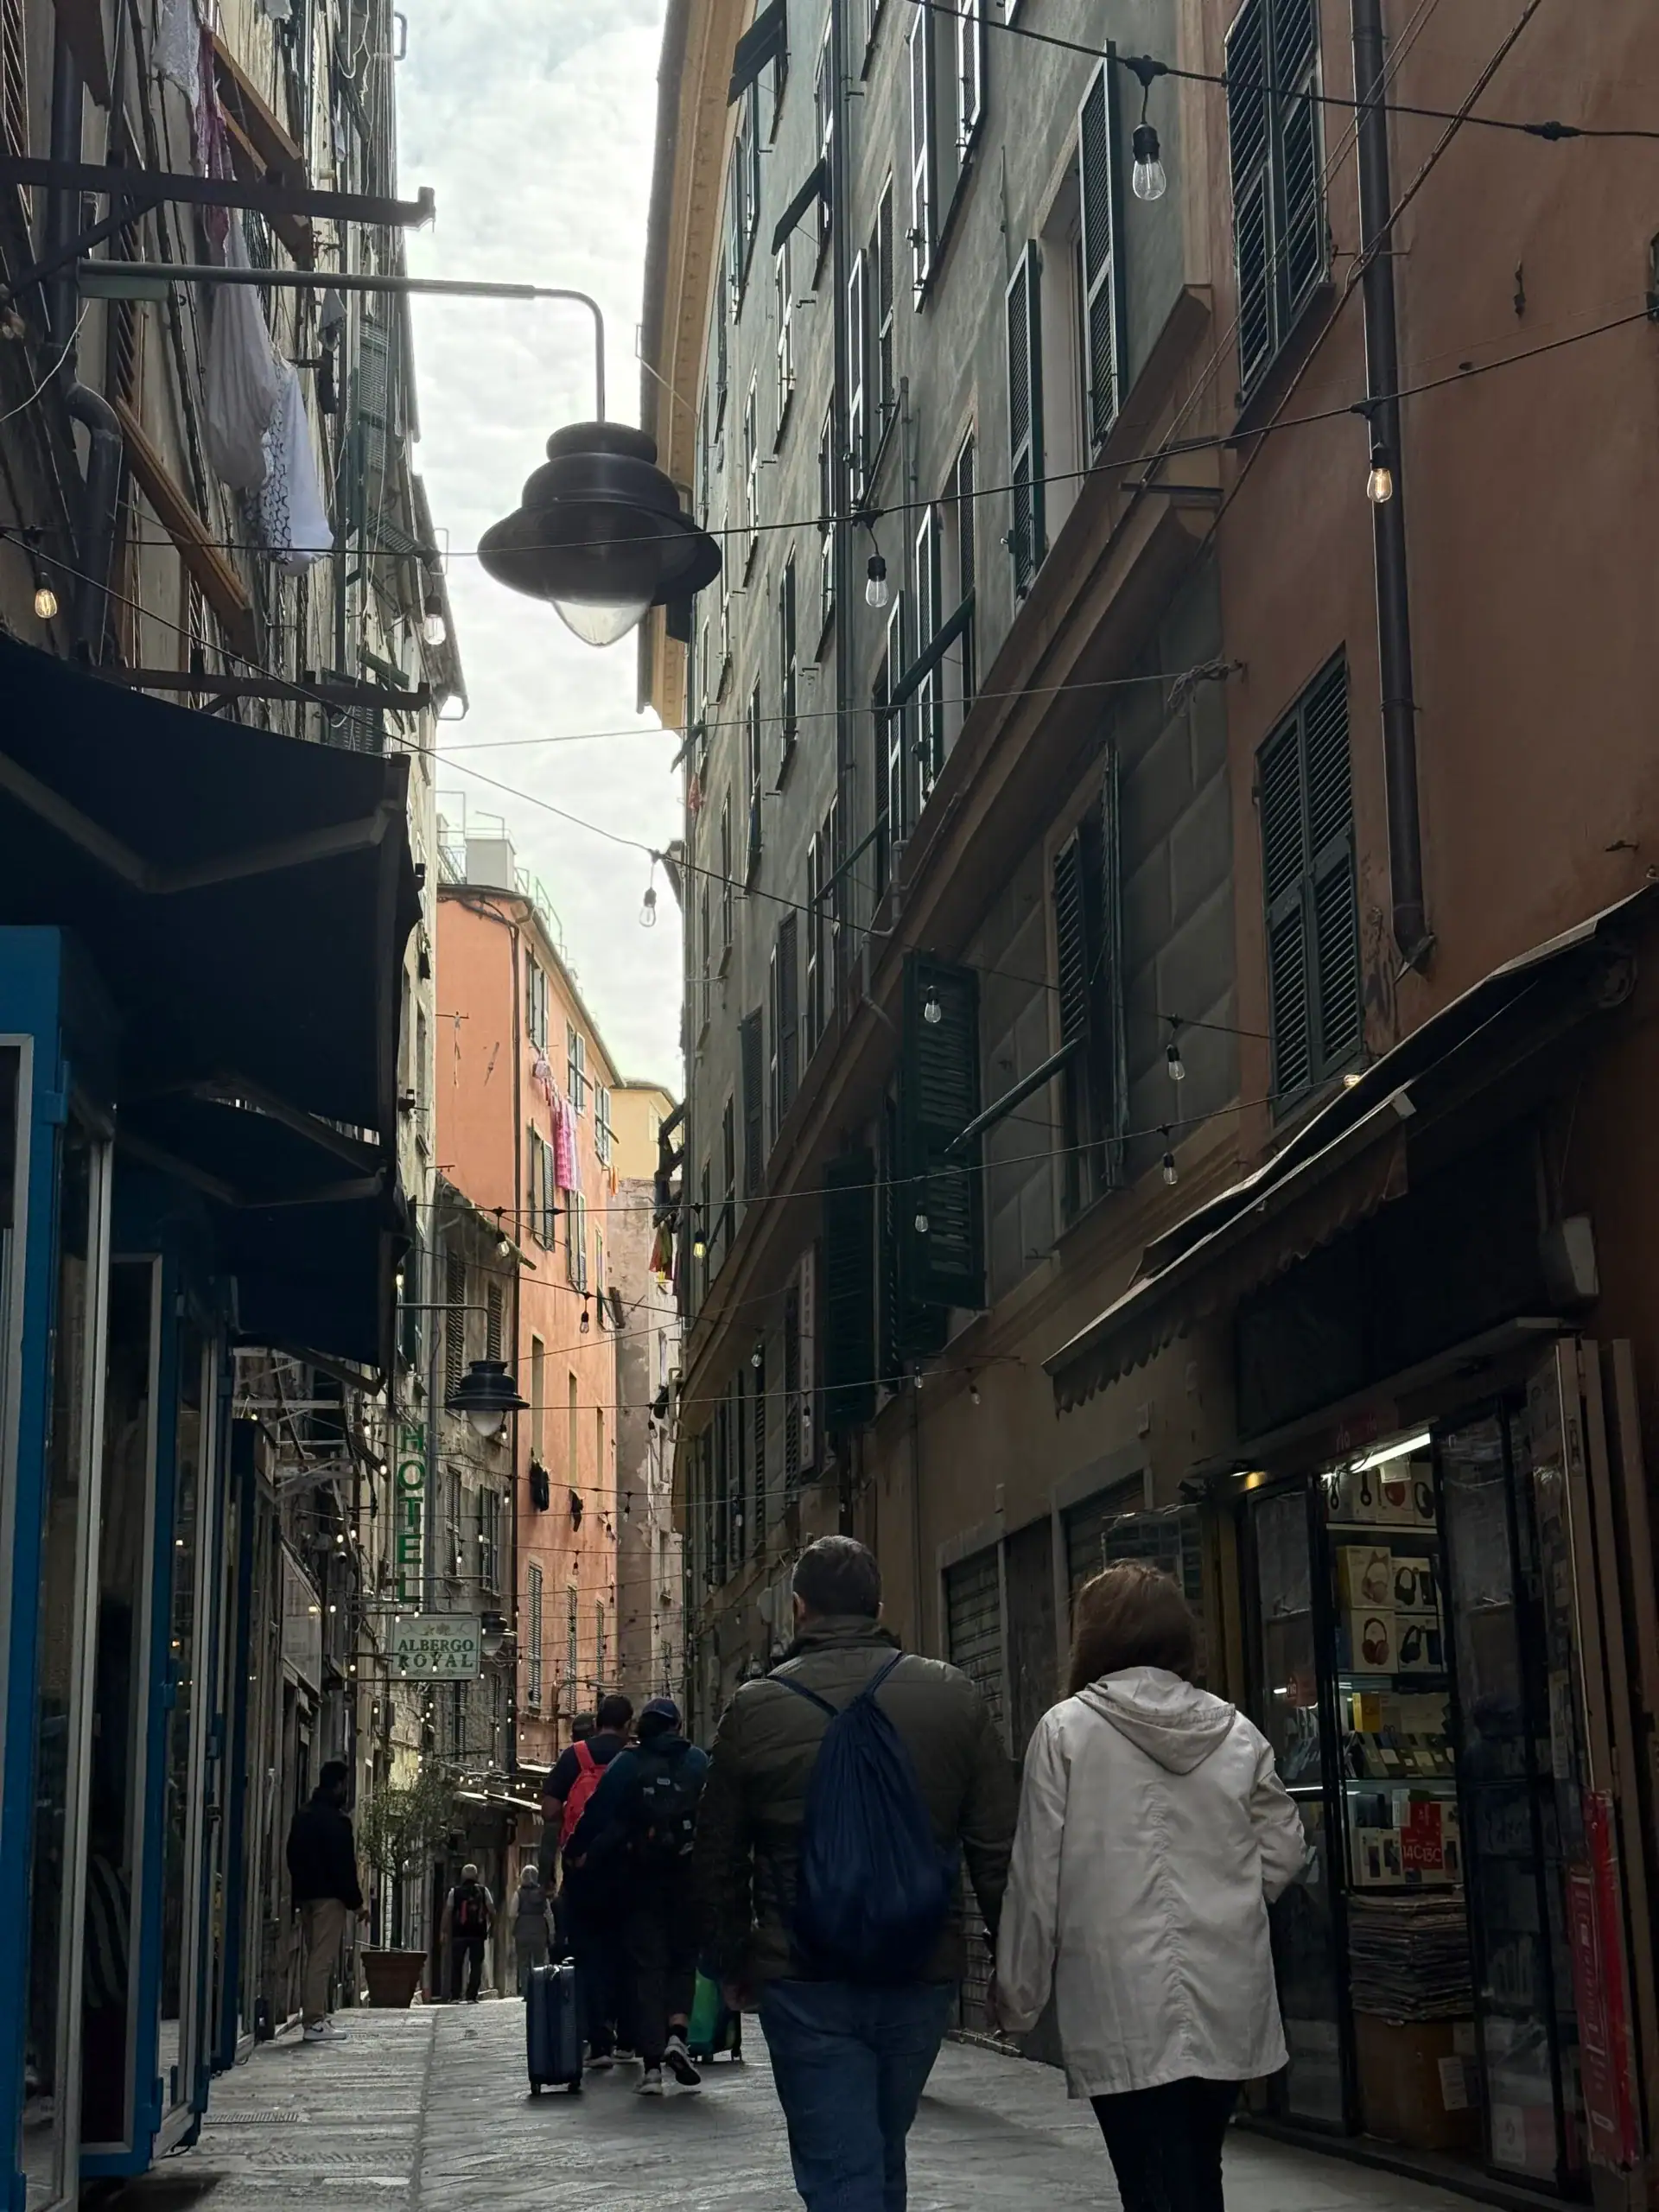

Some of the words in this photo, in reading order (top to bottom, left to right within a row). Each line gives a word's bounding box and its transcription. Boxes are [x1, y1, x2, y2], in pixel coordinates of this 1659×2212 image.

[397, 1424, 425, 1604] HOTEL
[397, 1639, 474, 1651] ALBERGO
[397, 1653, 474, 1669] ROYAL
